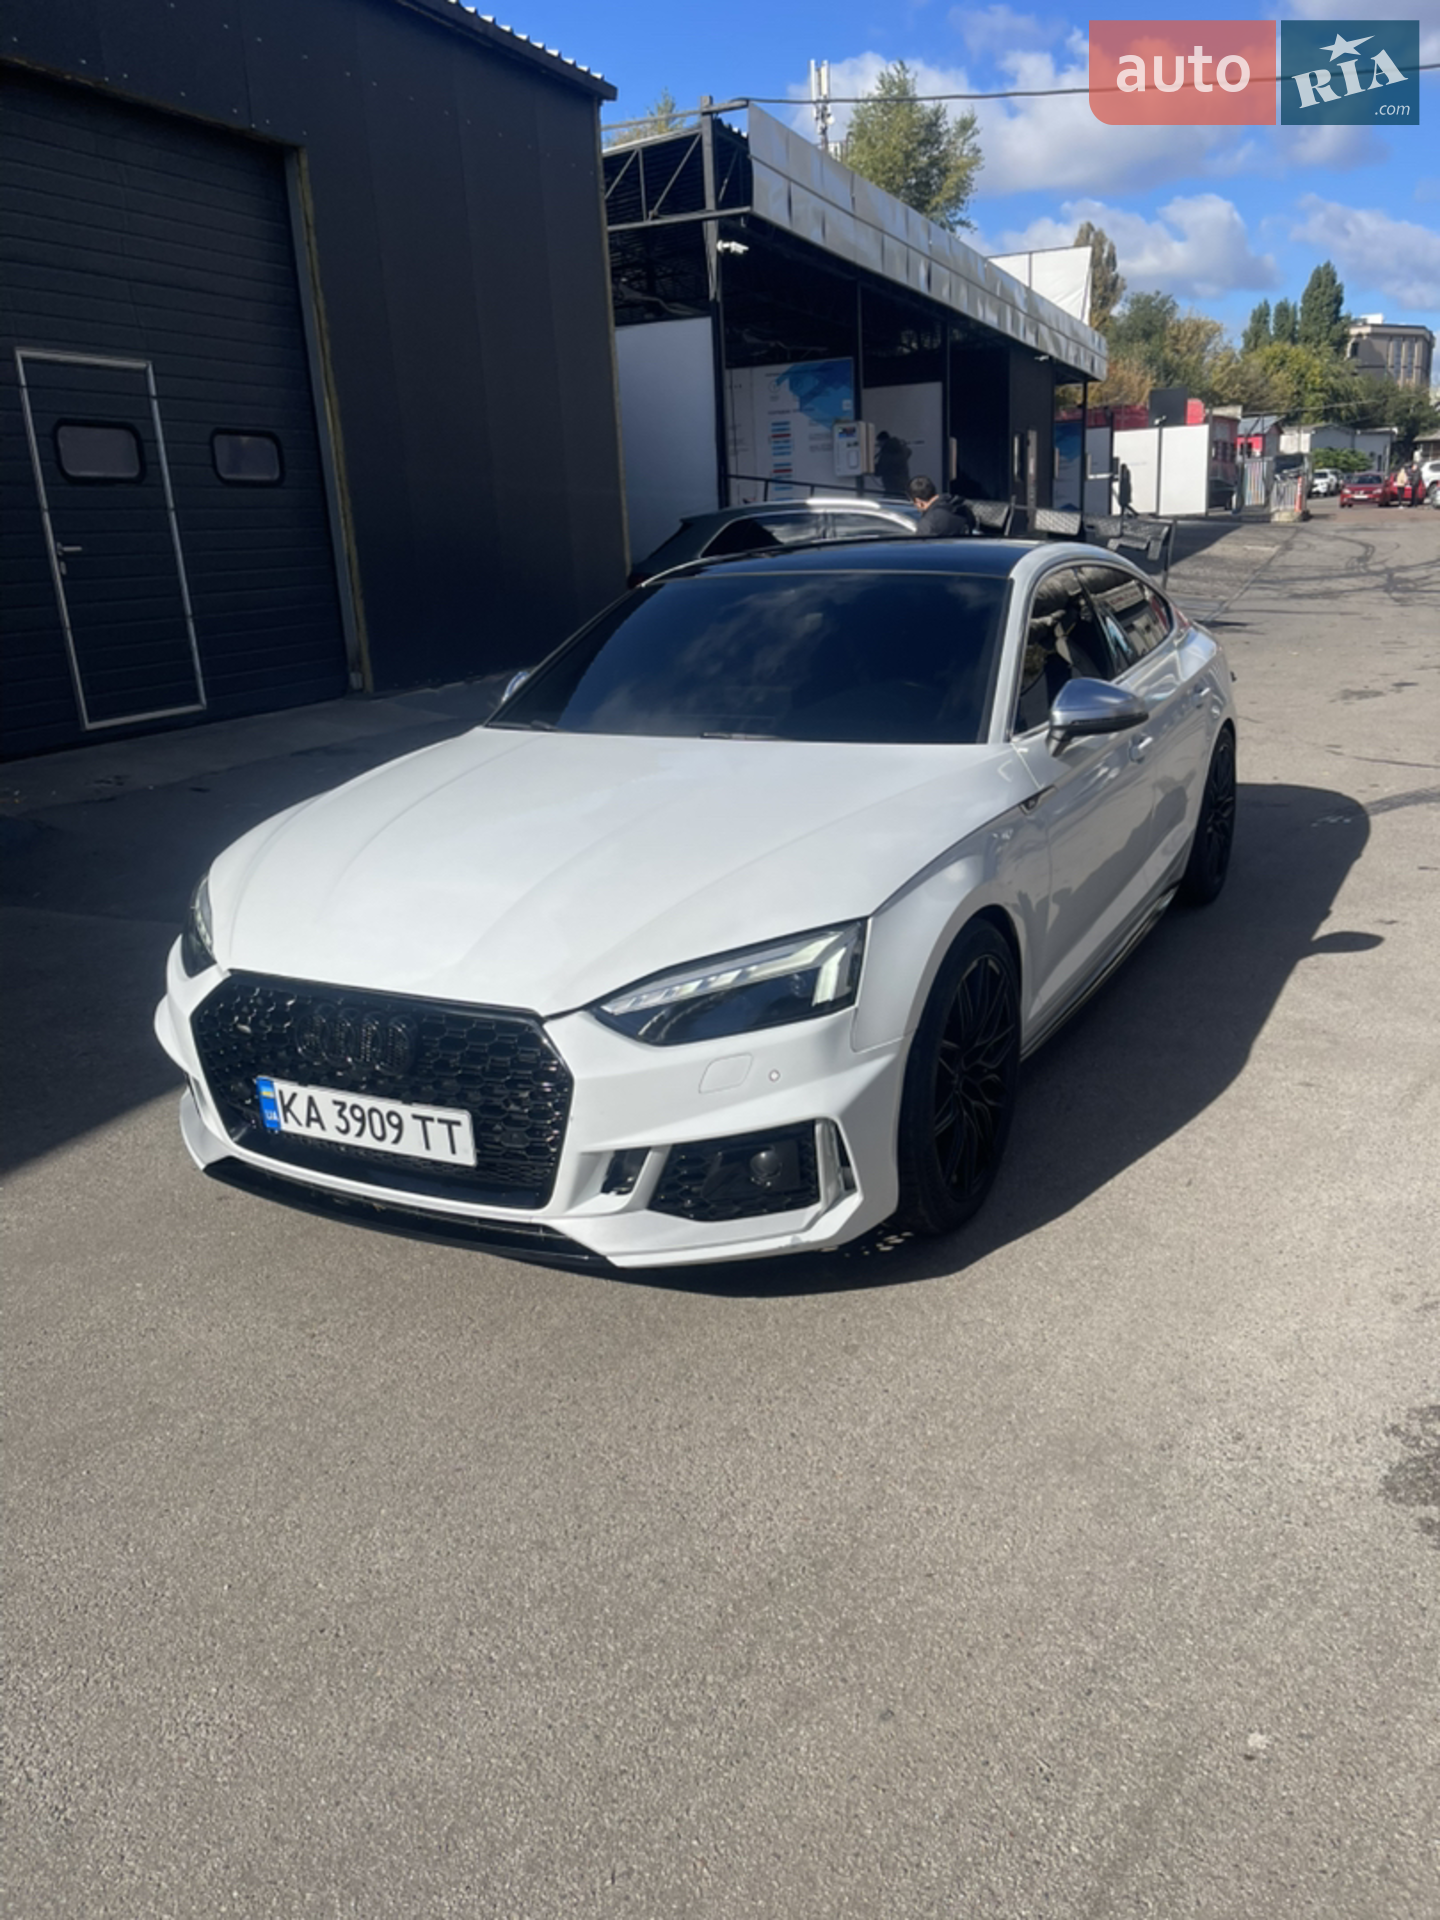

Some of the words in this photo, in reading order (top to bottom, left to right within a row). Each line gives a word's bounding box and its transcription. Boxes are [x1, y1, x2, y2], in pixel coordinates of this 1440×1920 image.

[279, 1089, 326, 1131] KA
[332, 1099, 404, 1144] 3909
[411, 1113, 462, 1155] TT
